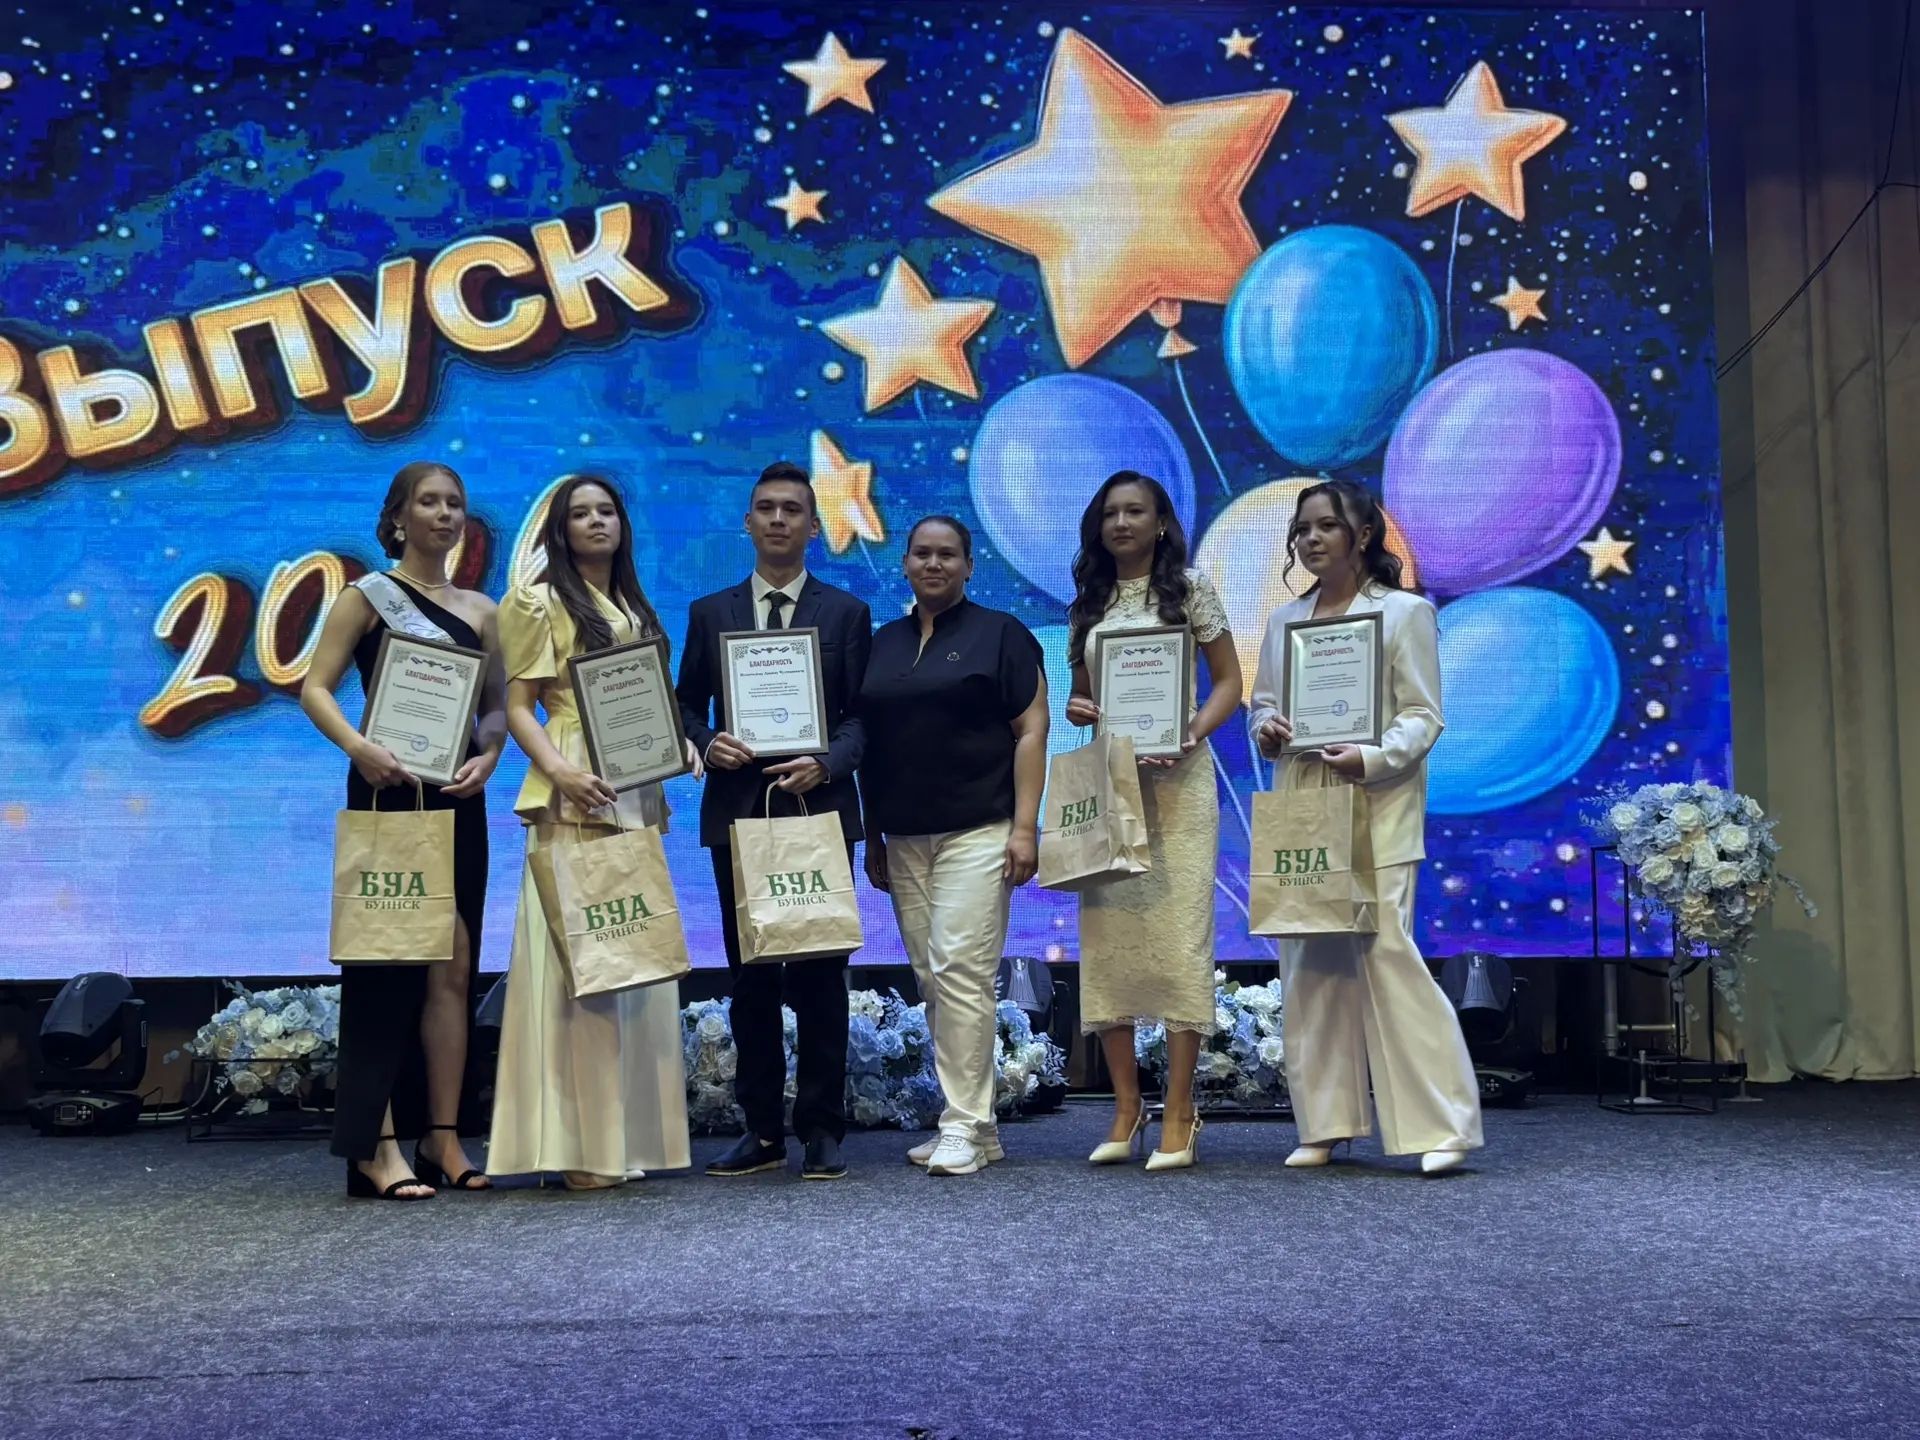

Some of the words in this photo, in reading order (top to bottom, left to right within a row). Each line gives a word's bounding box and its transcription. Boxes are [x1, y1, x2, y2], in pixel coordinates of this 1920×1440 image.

[749, 658, 793, 668] БЛАГОДАРНОСТЬ
[1059, 797, 1099, 828] БУА
[1272, 846, 1331, 875] БУА
[358, 871, 428, 898] БУА
[766, 869, 829, 898] БУА
[1278, 874, 1326, 888] БУИНСК
[364, 899, 421, 911] БУИНСК
[582, 892, 653, 931] БУА
[776, 894, 827, 909] БУИНСК
[595, 921, 648, 943] БУИНСК
